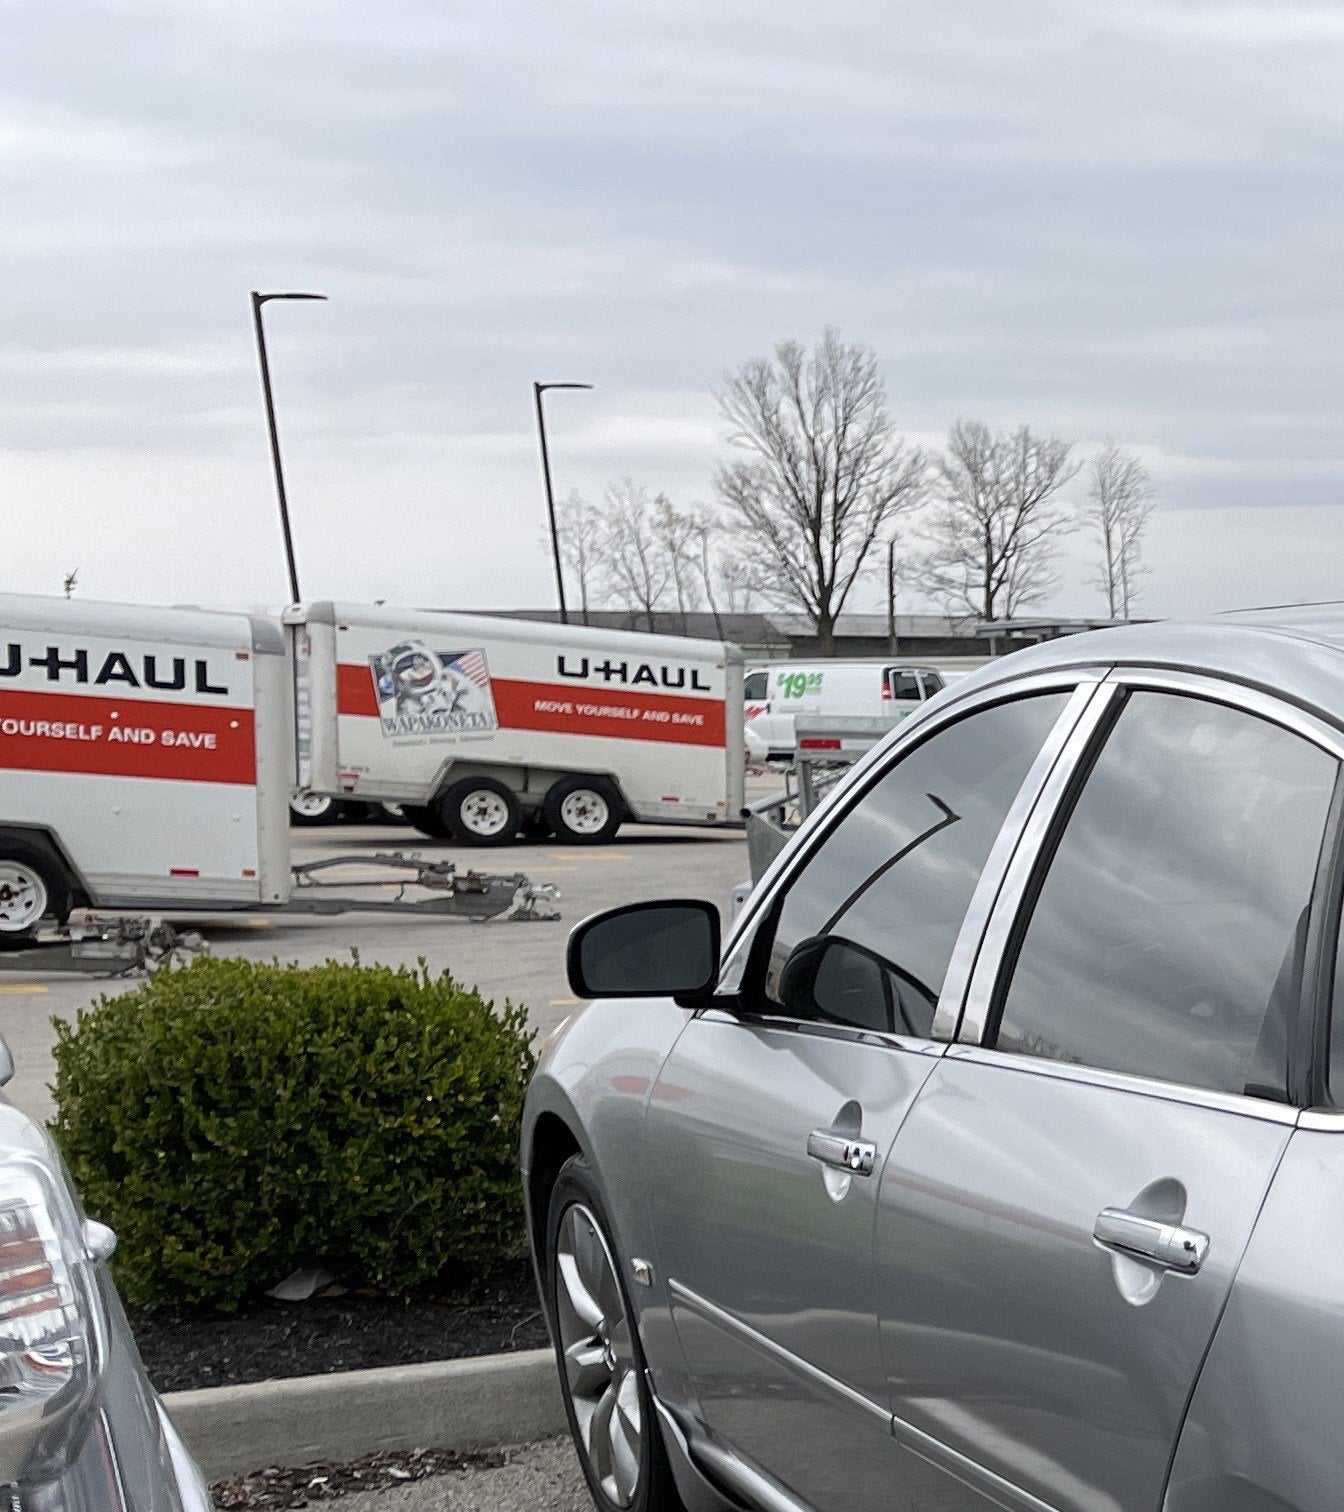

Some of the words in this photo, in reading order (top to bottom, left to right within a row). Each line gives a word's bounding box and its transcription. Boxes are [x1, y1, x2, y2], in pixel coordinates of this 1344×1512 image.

[557, 655, 711, 691] U-HAUL
[534, 699, 574, 715] MOVE
[575, 703, 641, 720] YOURSELF
[642, 709, 671, 723] AND
[671, 711, 705, 727] SAVE
[0, 717, 104, 741] OURSELF
[107, 726, 156, 744] AND
[160, 730, 218, 750] SAVE
